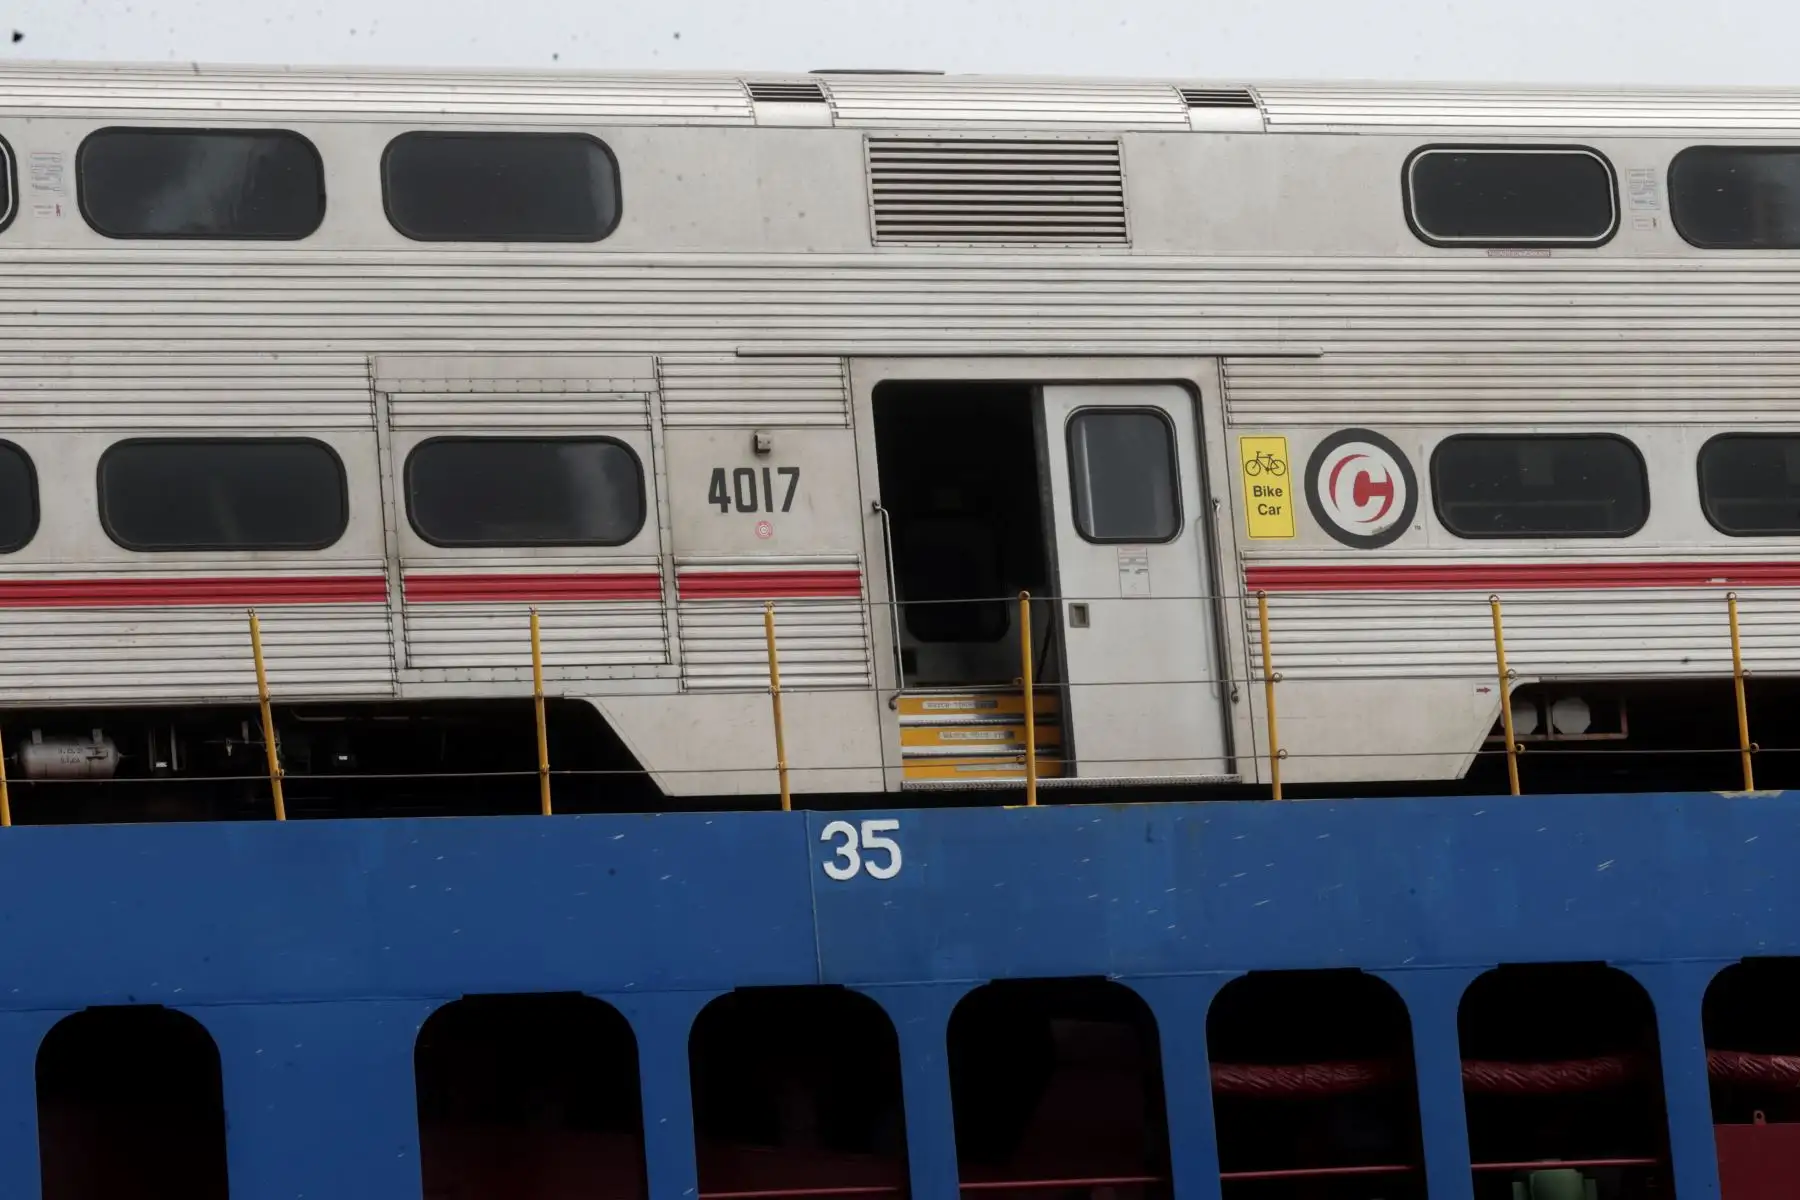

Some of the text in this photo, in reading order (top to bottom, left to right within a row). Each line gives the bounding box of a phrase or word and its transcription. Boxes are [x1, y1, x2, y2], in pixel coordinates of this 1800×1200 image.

[708, 466, 800, 513] 4017
[1253, 485, 1283, 497] Bike
[1257, 503, 1282, 515] Car
[820, 819, 902, 880] 35
